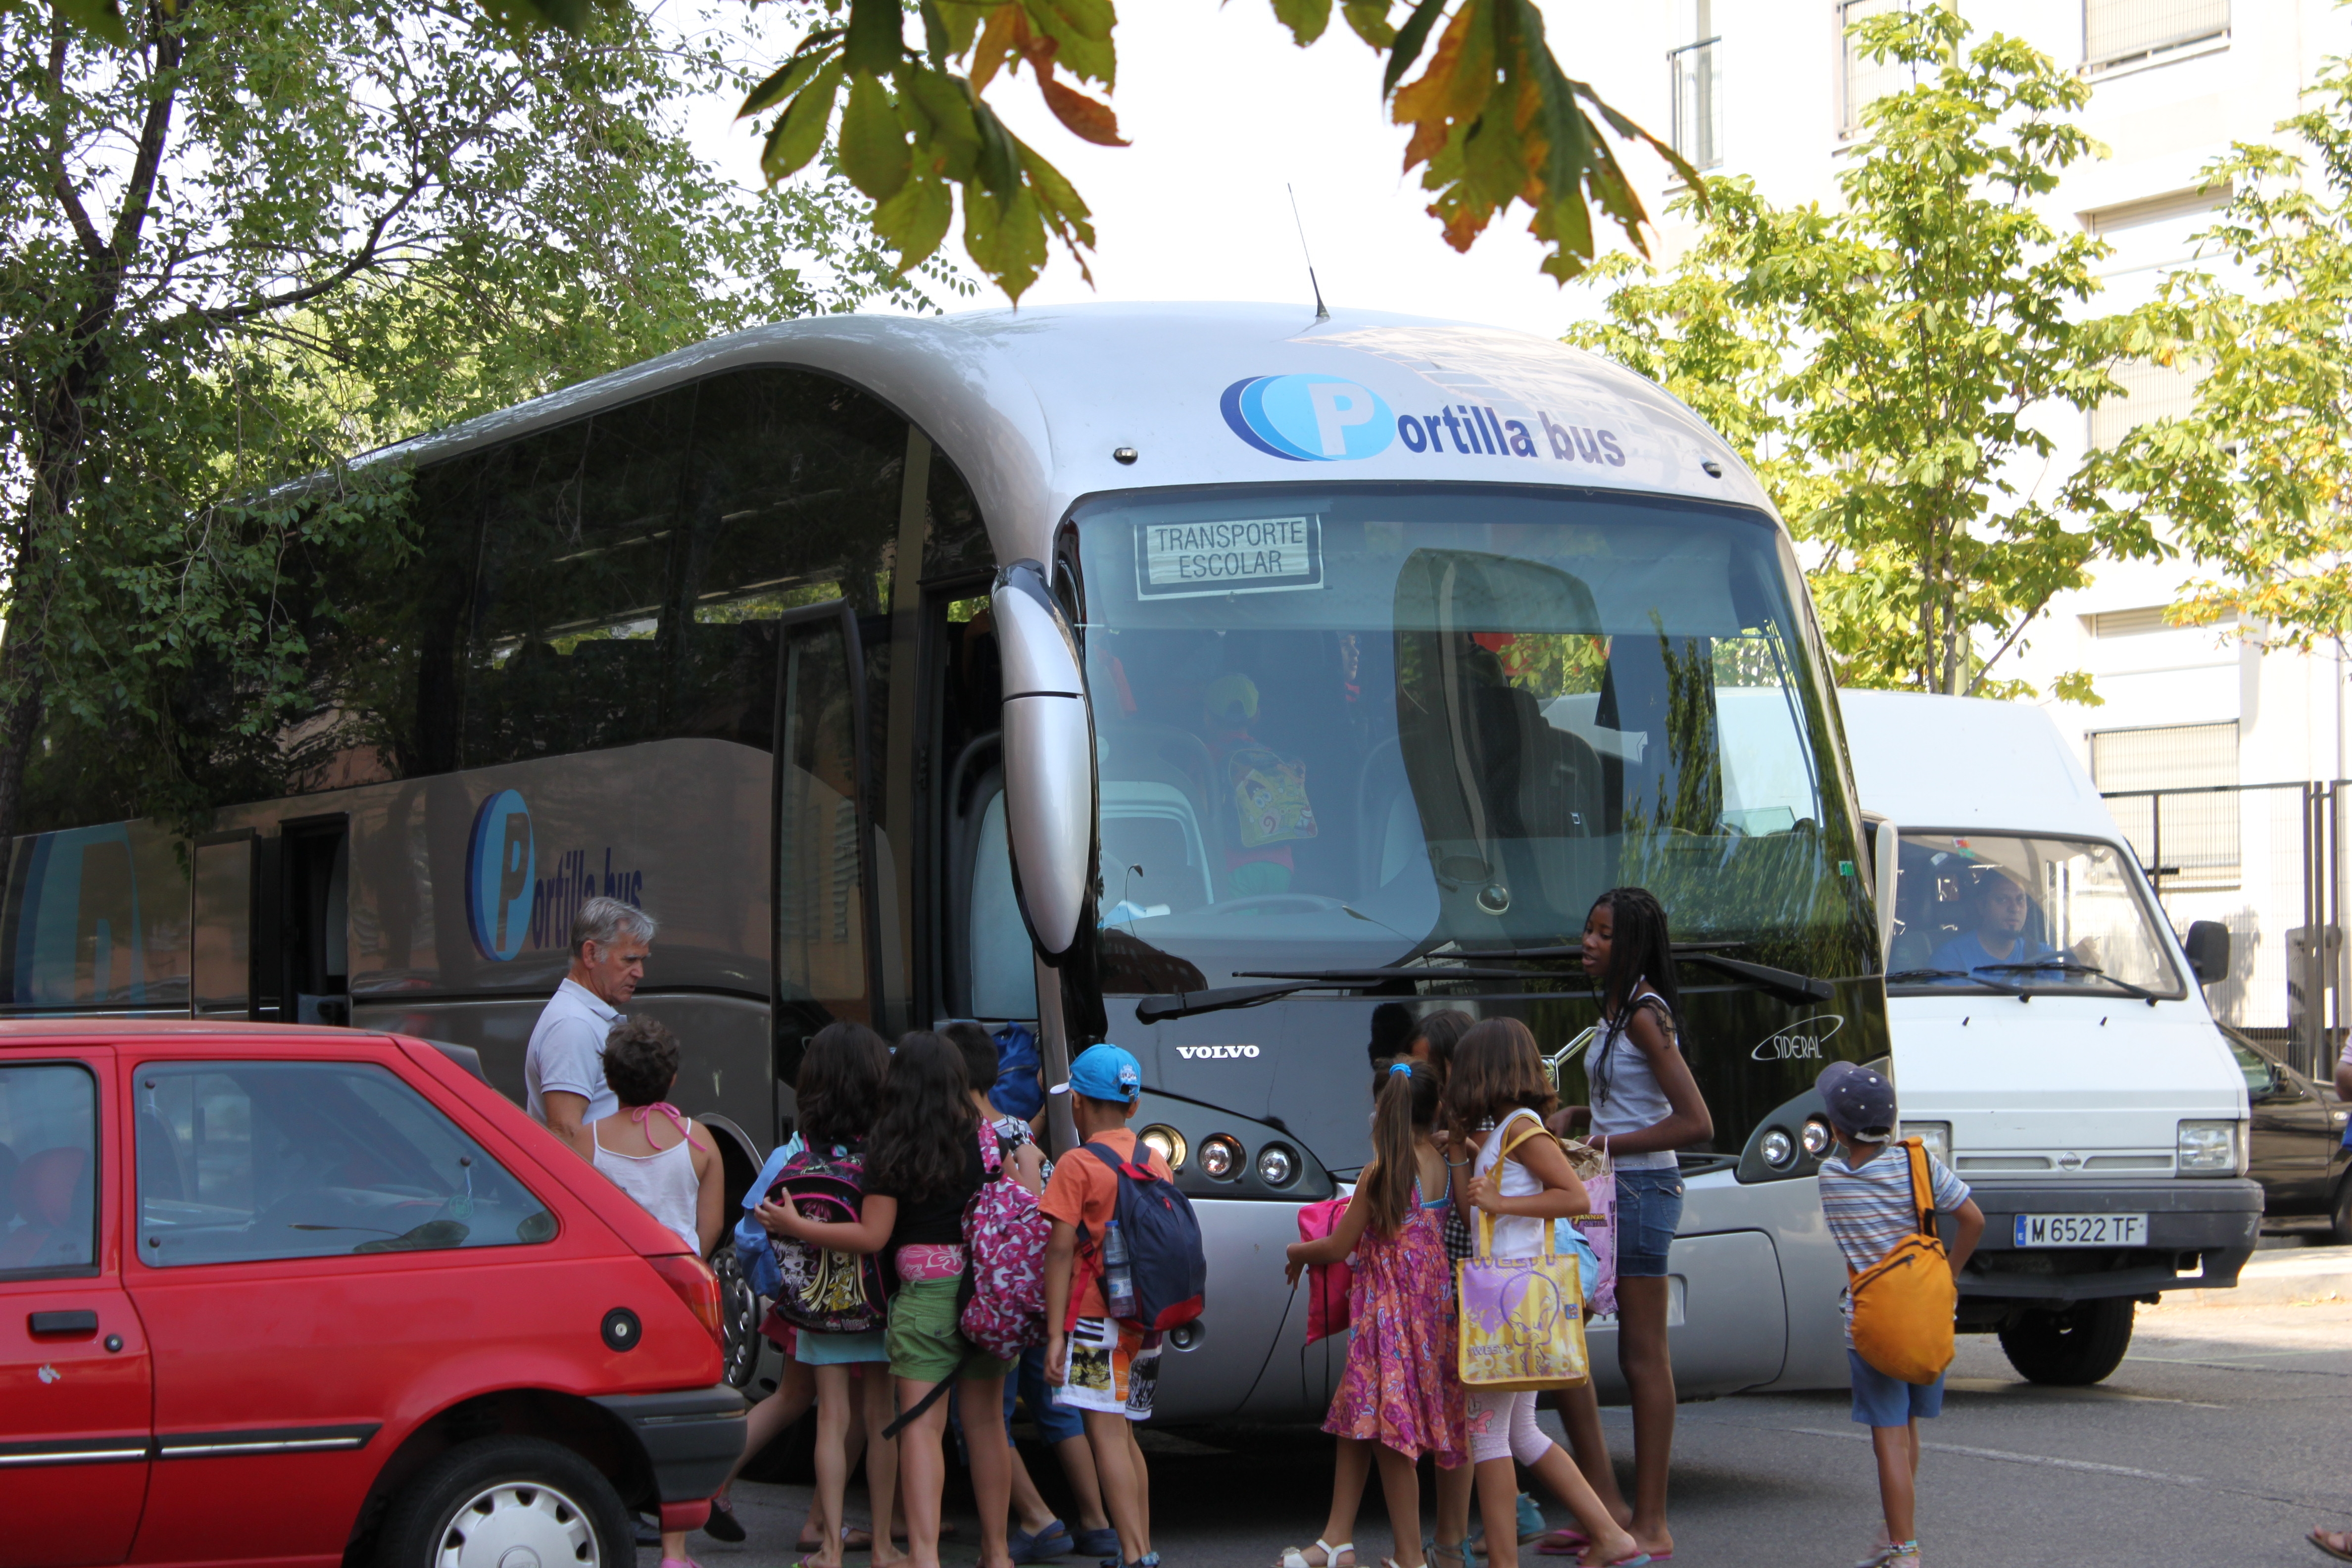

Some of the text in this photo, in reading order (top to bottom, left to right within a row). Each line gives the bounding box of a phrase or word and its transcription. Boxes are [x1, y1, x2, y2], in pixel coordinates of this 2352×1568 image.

[1538, 411, 1626, 468] bus
[1155, 520, 1304, 552] TRANSPORTE
[1178, 550, 1283, 579] ESCOLAR
[1176, 1045, 1260, 1060] VOLVO
[1773, 1035, 1823, 1059] SIDERAL
[2032, 1217, 2139, 1242] M 6522 TF
